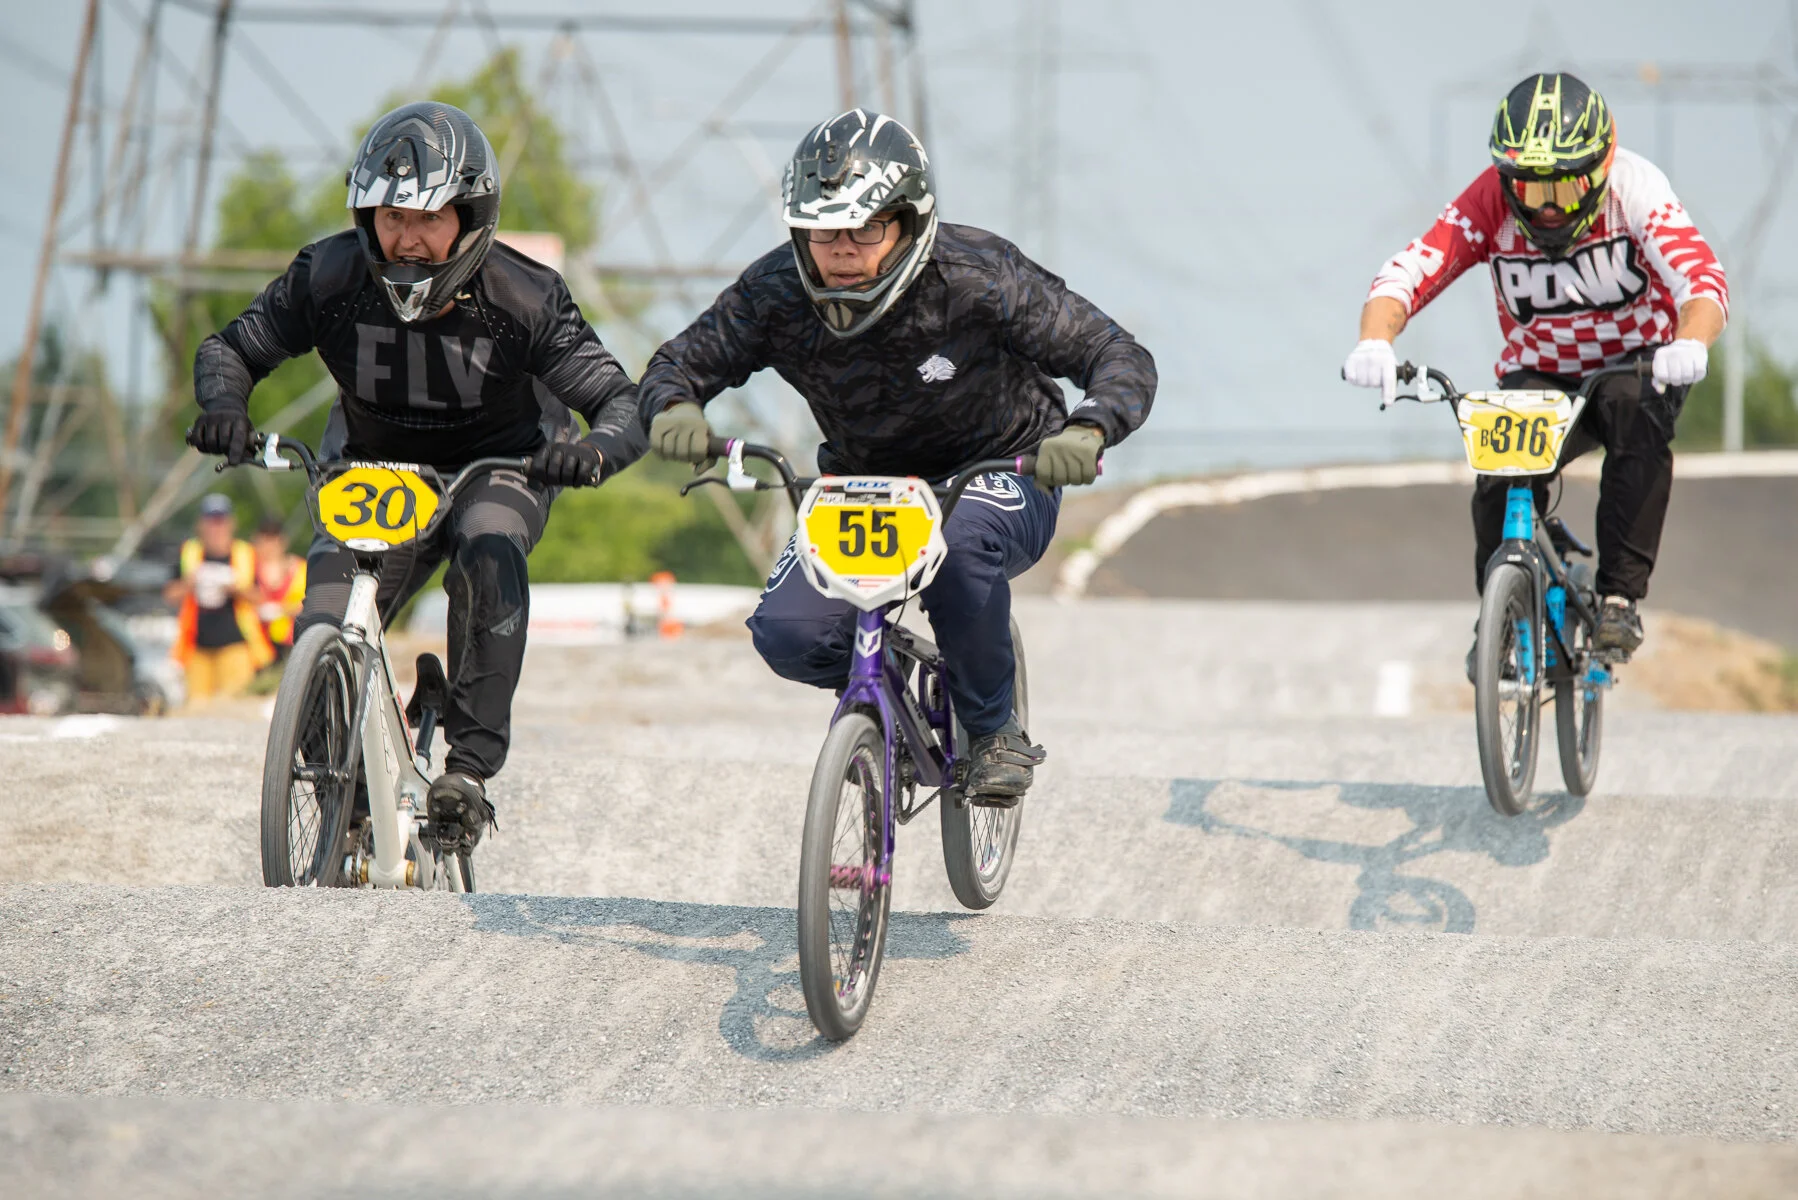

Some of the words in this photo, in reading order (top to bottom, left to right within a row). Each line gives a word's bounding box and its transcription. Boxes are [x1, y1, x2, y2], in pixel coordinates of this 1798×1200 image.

[1498, 239, 1644, 316] PONK
[355, 322, 494, 409] FLY
[1491, 415, 1549, 457] 316
[333, 482, 417, 530] 30
[838, 510, 899, 558] 55
